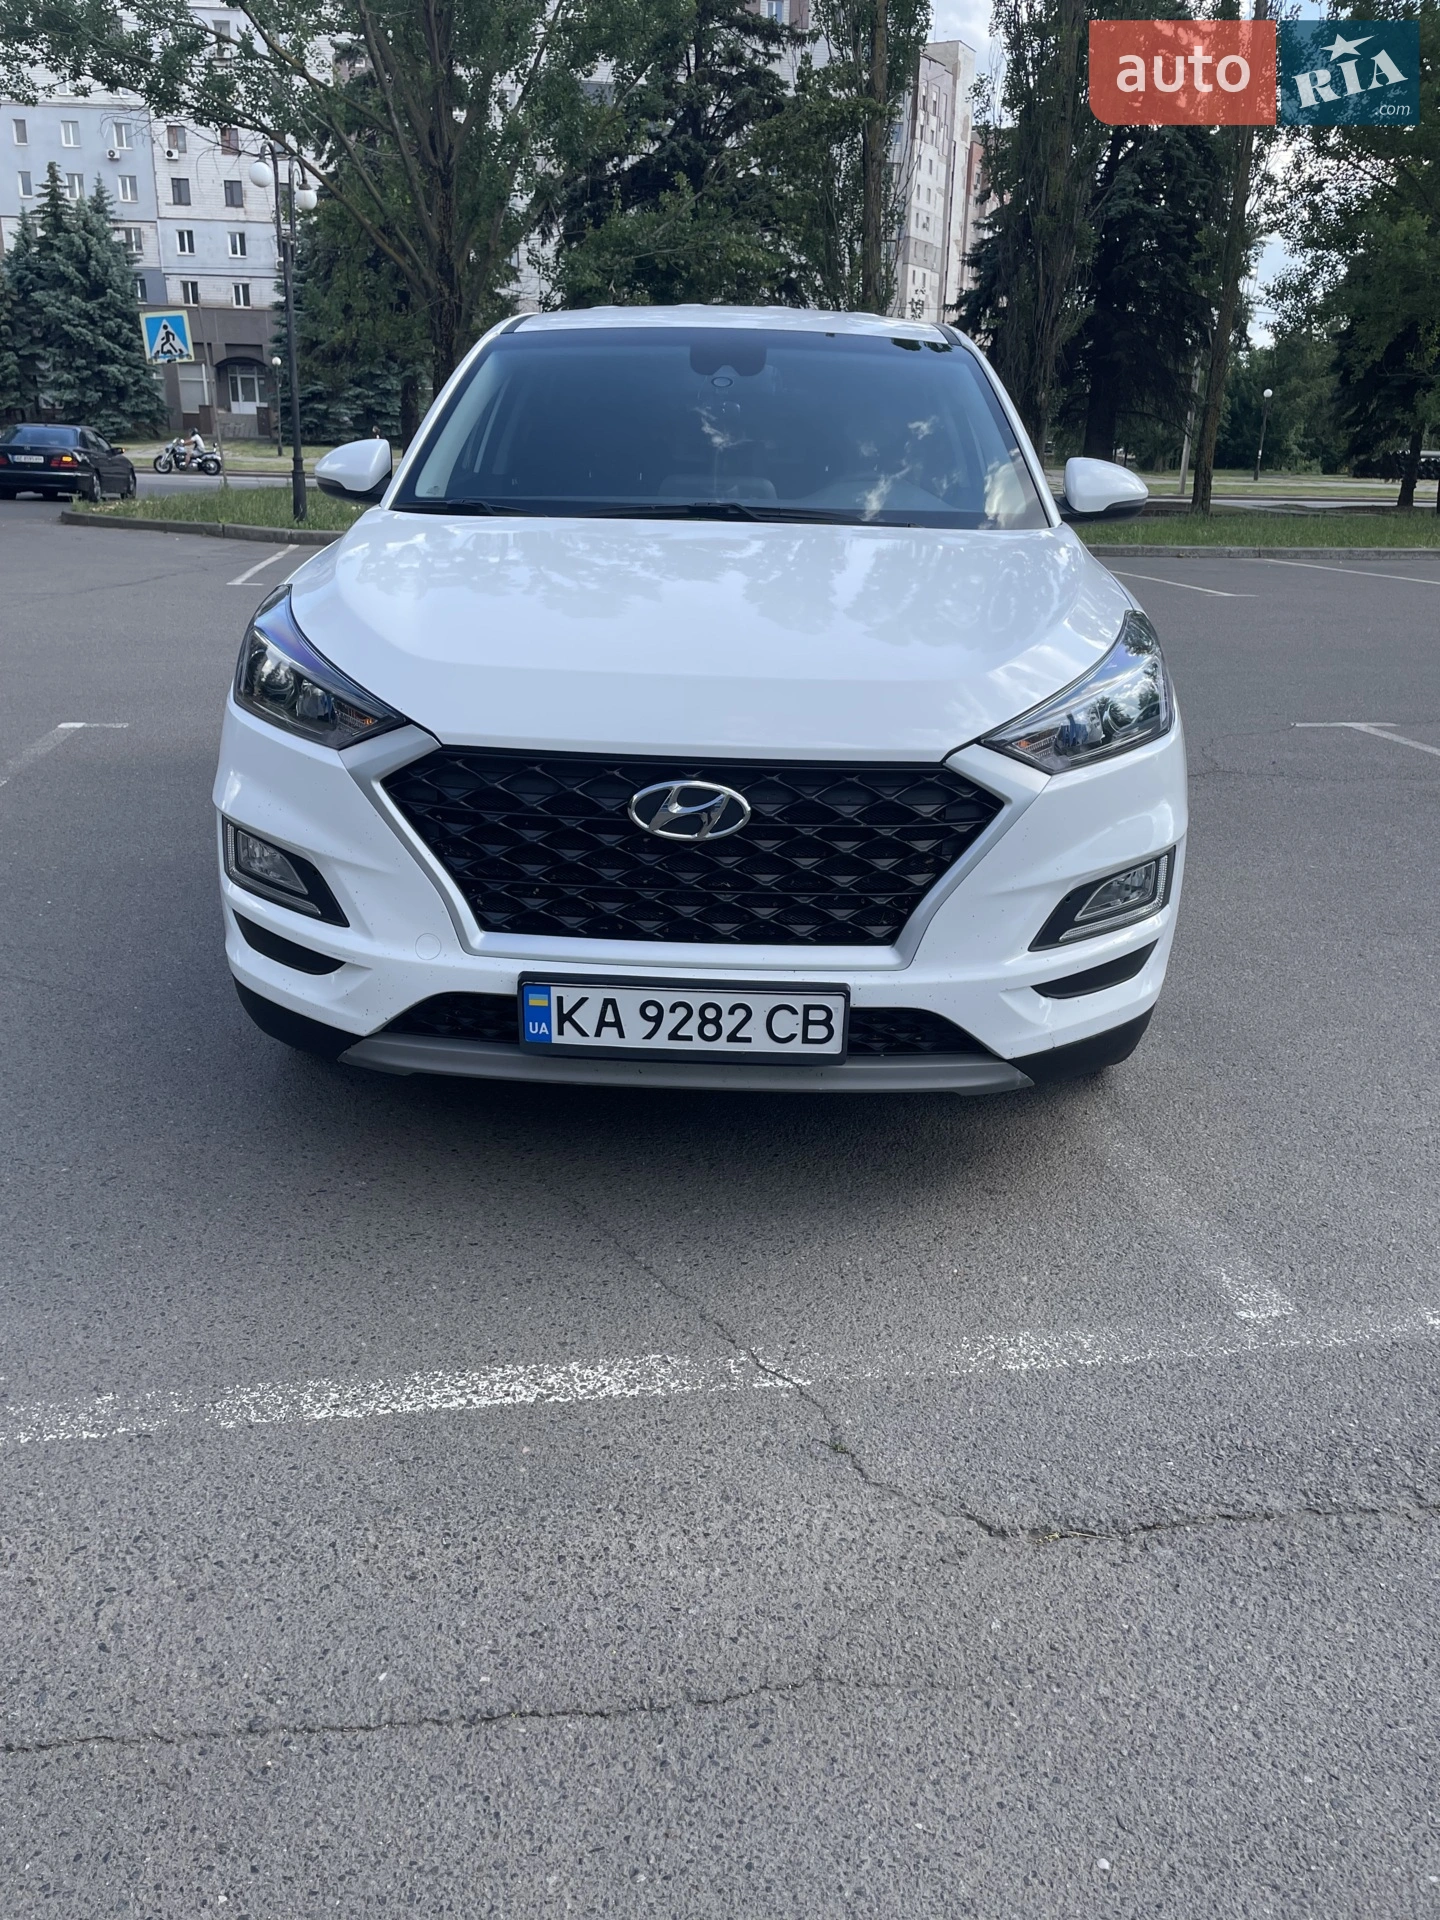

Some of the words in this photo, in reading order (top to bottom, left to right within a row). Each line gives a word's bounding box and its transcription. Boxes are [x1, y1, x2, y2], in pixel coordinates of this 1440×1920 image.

[529, 1021, 549, 1035] UA
[556, 995, 626, 1039] KA
[639, 999, 753, 1043] 9282
[765, 1003, 835, 1045] CB
